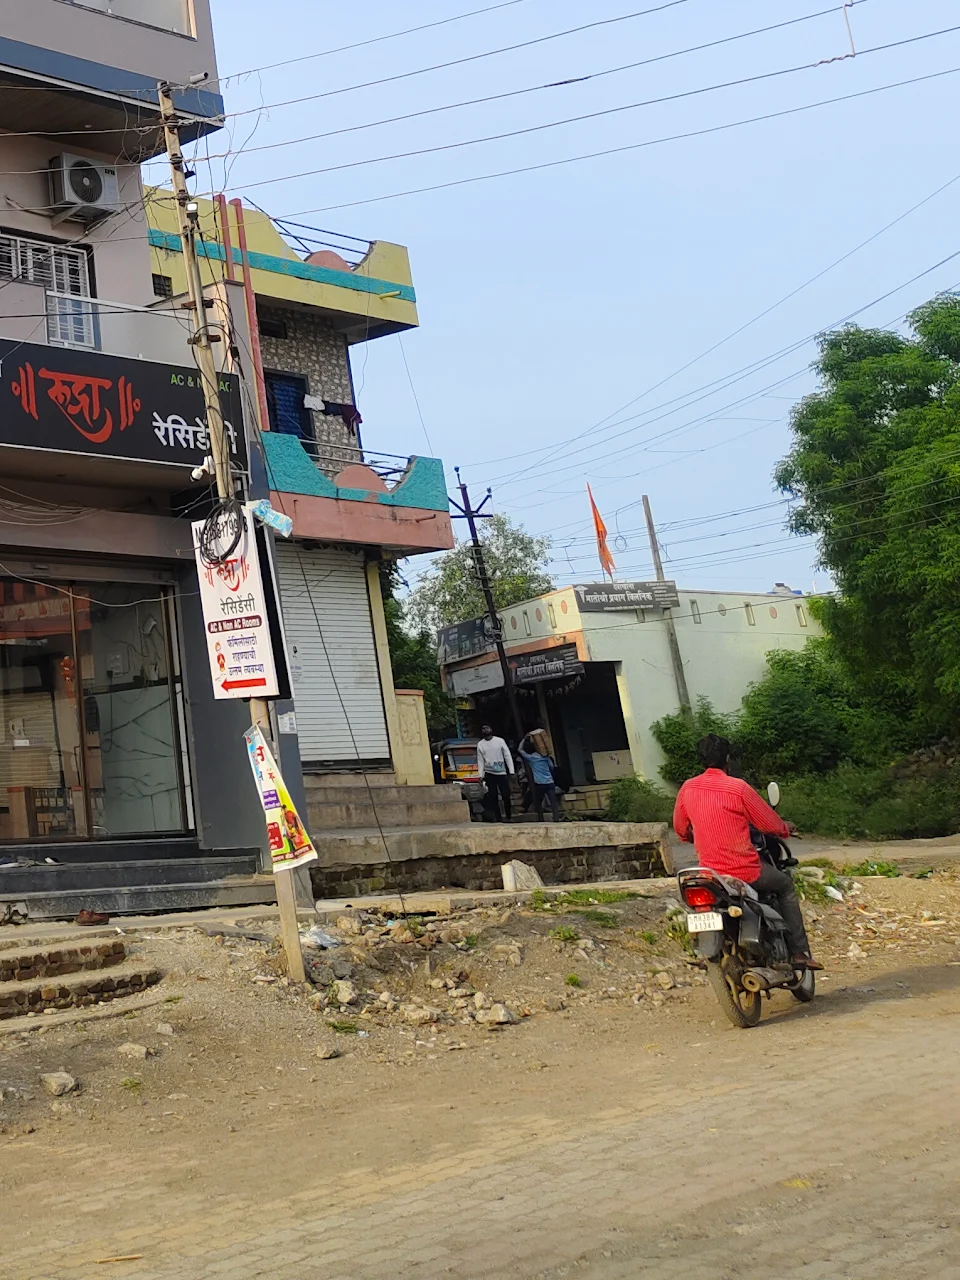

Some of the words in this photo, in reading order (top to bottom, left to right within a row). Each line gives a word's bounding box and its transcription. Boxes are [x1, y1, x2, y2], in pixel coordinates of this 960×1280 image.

[170, 374, 184, 386] AC
[187, 376, 194, 387] &
[220, 592, 256, 615] रेसिडेंसी
[210, 622, 218, 632] AC
[223, 620, 233, 629] Non
[234, 619, 241, 628] AC
[242, 617, 260, 627] Rooms
